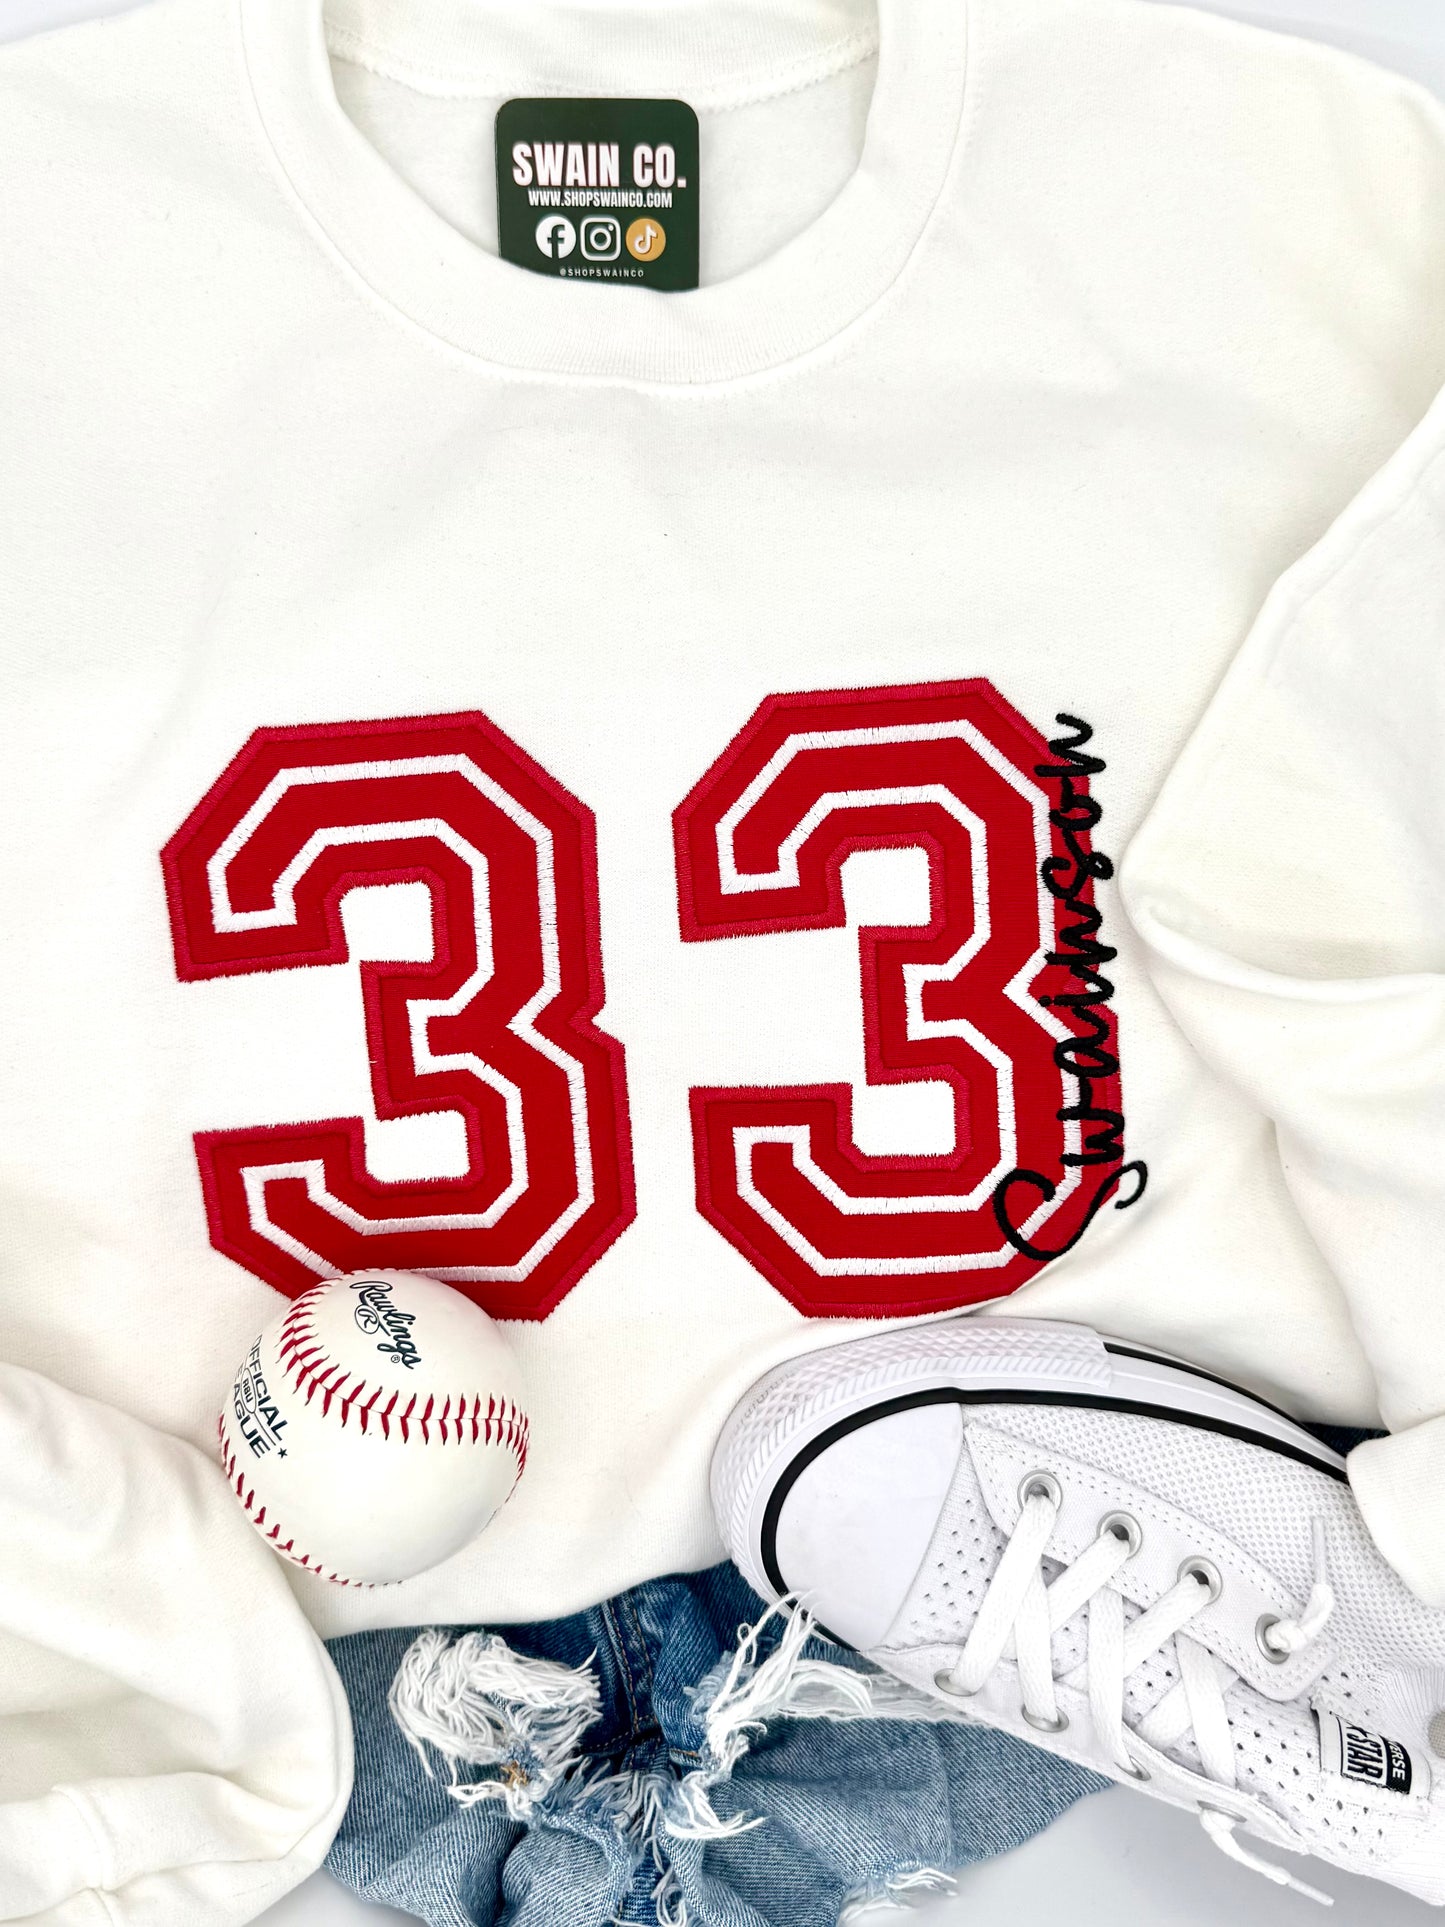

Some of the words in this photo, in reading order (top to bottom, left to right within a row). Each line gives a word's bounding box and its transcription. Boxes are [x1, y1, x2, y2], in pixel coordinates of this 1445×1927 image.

[512, 141, 620, 187] SWAIN
[633, 143, 687, 188] CO.
[528, 190, 673, 208] WWW.SHOPSWAINCO.COM
[560, 267, 645, 277] @SHOPSWAINCO
[993, 712, 1147, 1261] Swainson
[350, 1280, 422, 1370] Rawlings
[234, 1361, 271, 1459] EAGUE
